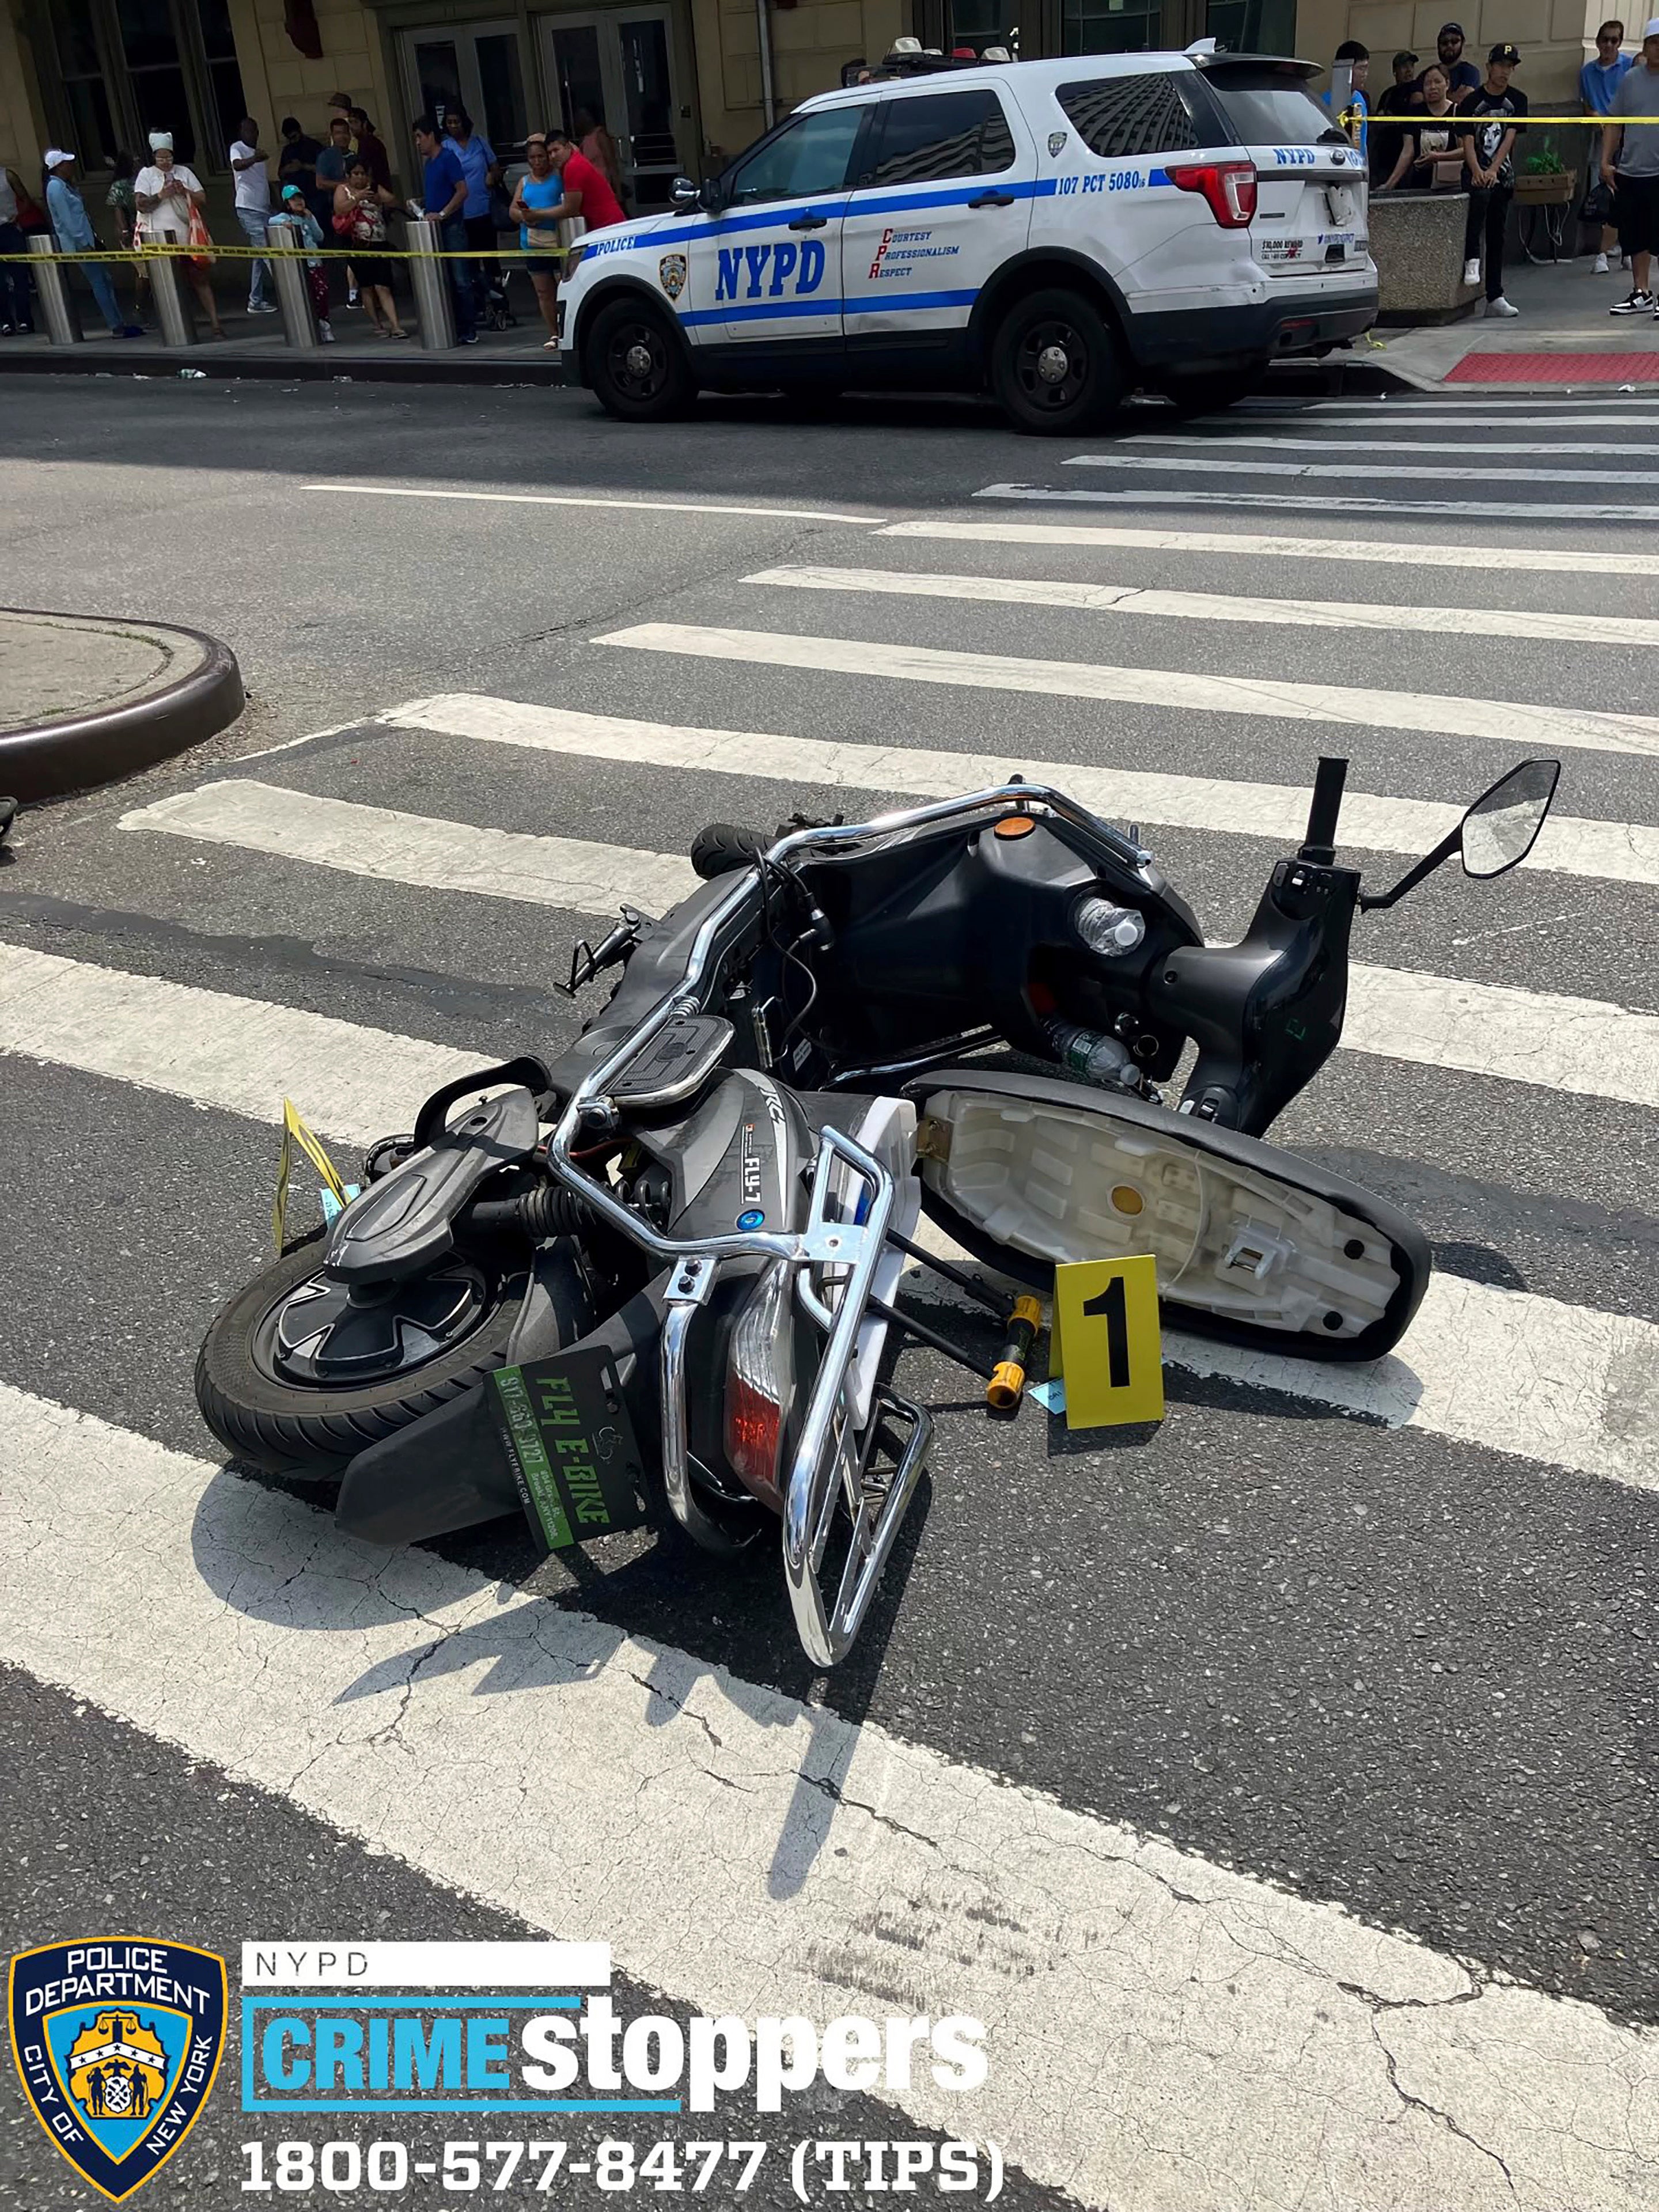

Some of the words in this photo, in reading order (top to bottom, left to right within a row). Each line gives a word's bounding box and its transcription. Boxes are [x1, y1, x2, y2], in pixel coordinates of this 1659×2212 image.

[1504, 46, 1512, 55] P
[1273, 149, 1316, 164] NYPD
[1059, 177, 1079, 195] 107
[1082, 174, 1107, 193] PCT
[1108, 171, 1139, 191] 5080
[597, 236, 634, 255] POLICE
[882, 228, 932, 244] COURTESY
[874, 245, 960, 261] PROFESSIONALISM
[715, 240, 825, 301] NYPD
[868, 263, 912, 279] RESPECT
[1082, 1276, 1131, 1388] 1
[535, 1377, 581, 1426] FLY
[555, 1439, 611, 1524] E-BIKE
